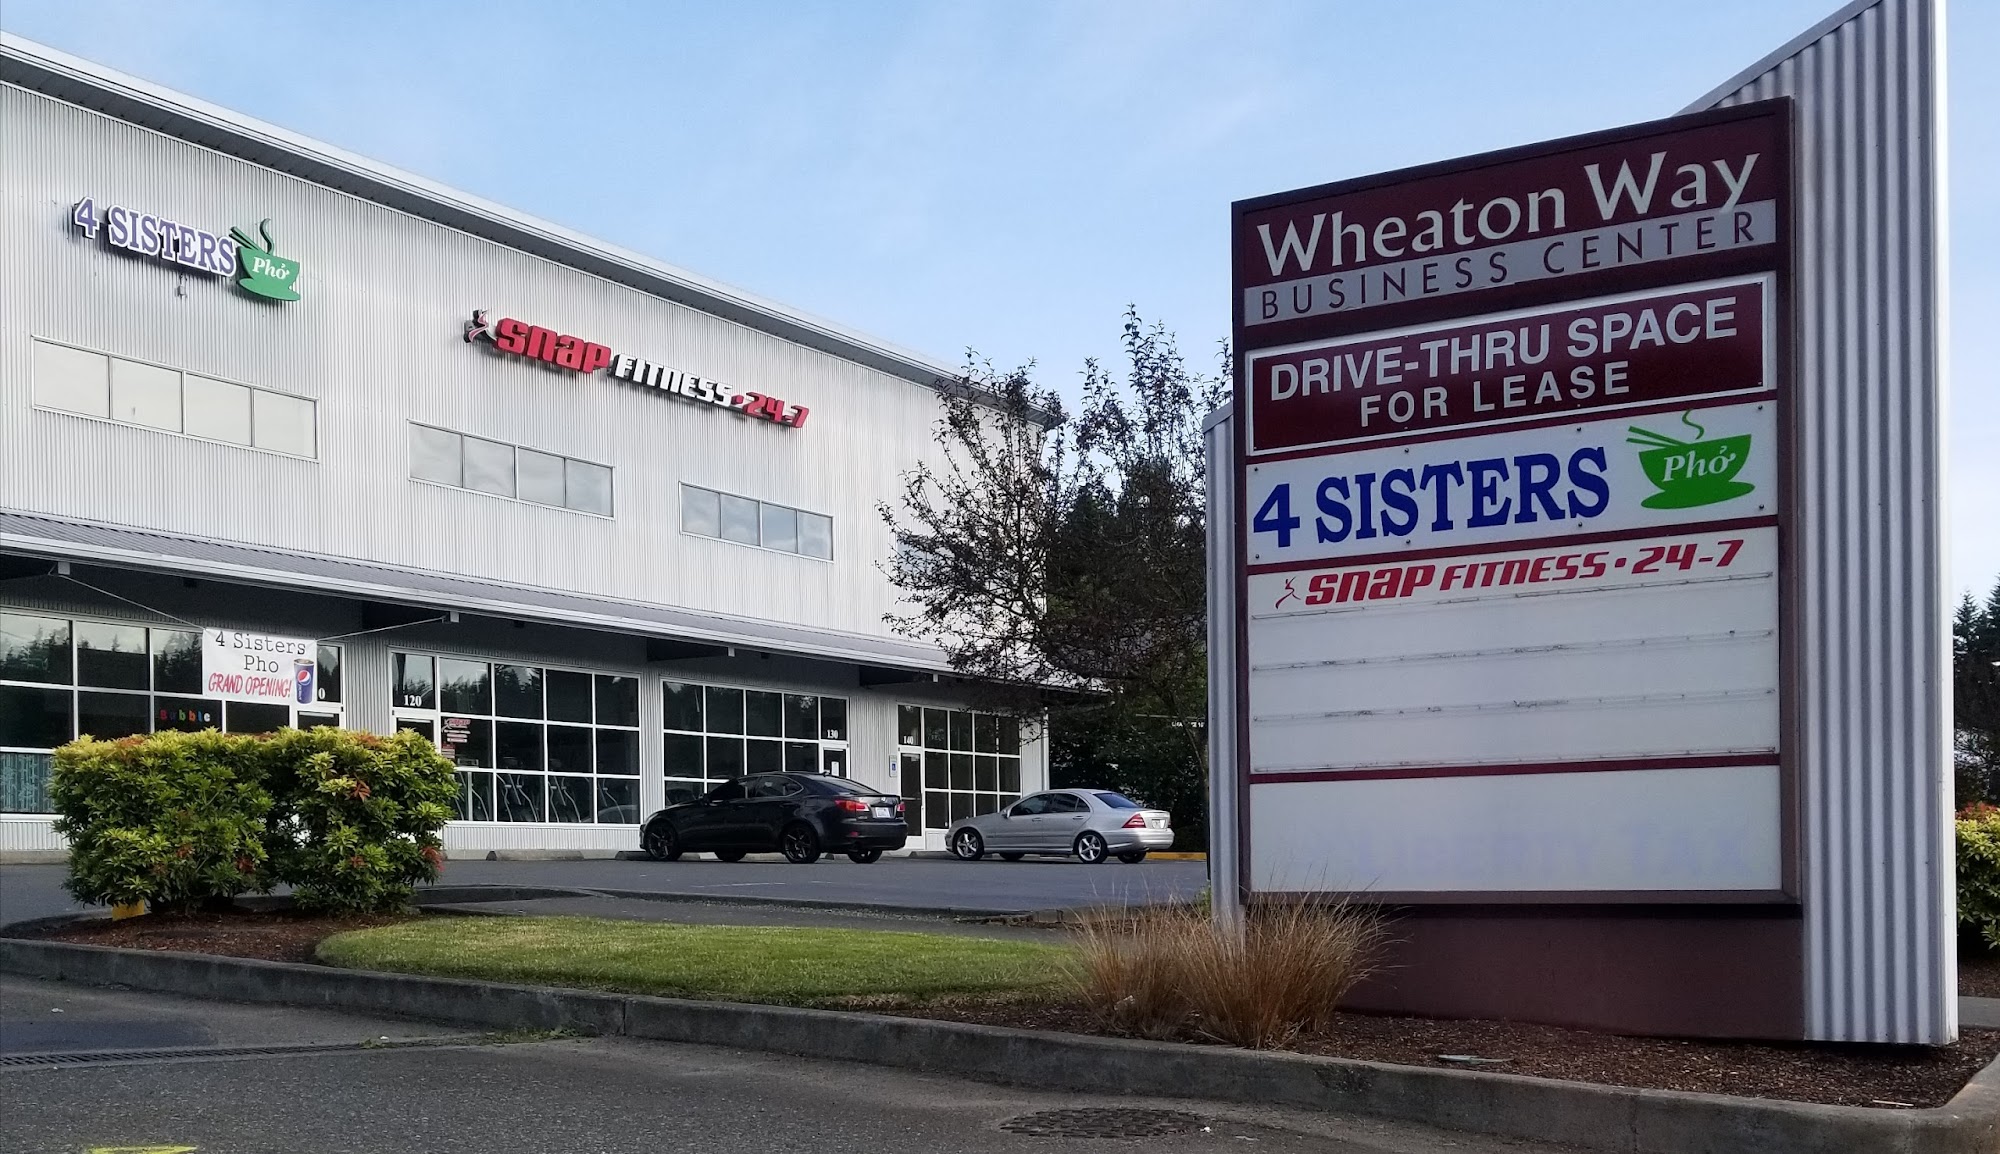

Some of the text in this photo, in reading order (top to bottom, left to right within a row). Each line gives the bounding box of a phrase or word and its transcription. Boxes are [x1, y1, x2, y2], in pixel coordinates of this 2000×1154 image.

[74, 196, 237, 277] 4 SISTERS
[1256, 151, 1761, 277] Wheaton Way
[1262, 210, 1755, 320] BUSINESS CENTER
[1271, 296, 1738, 402] DRIVE-THRU SPACE
[612, 353, 734, 408] FITNESS
[743, 391, 810, 429] 24-7
[1360, 360, 1631, 428] FOR LEASE
[1252, 446, 1610, 548] 4 SISTERS
[1439, 551, 1610, 592] FITNESS
[1631, 539, 1744, 575] 24-7
[215, 630, 306, 655] 4 Sisters
[243, 654, 279, 673] Pho
[208, 672, 244, 694] GRAND
[245, 676, 292, 698] OPENING!
[403, 694, 422, 707] 120
[826, 729, 839, 739] 130
[903, 735, 914, 745] 140
